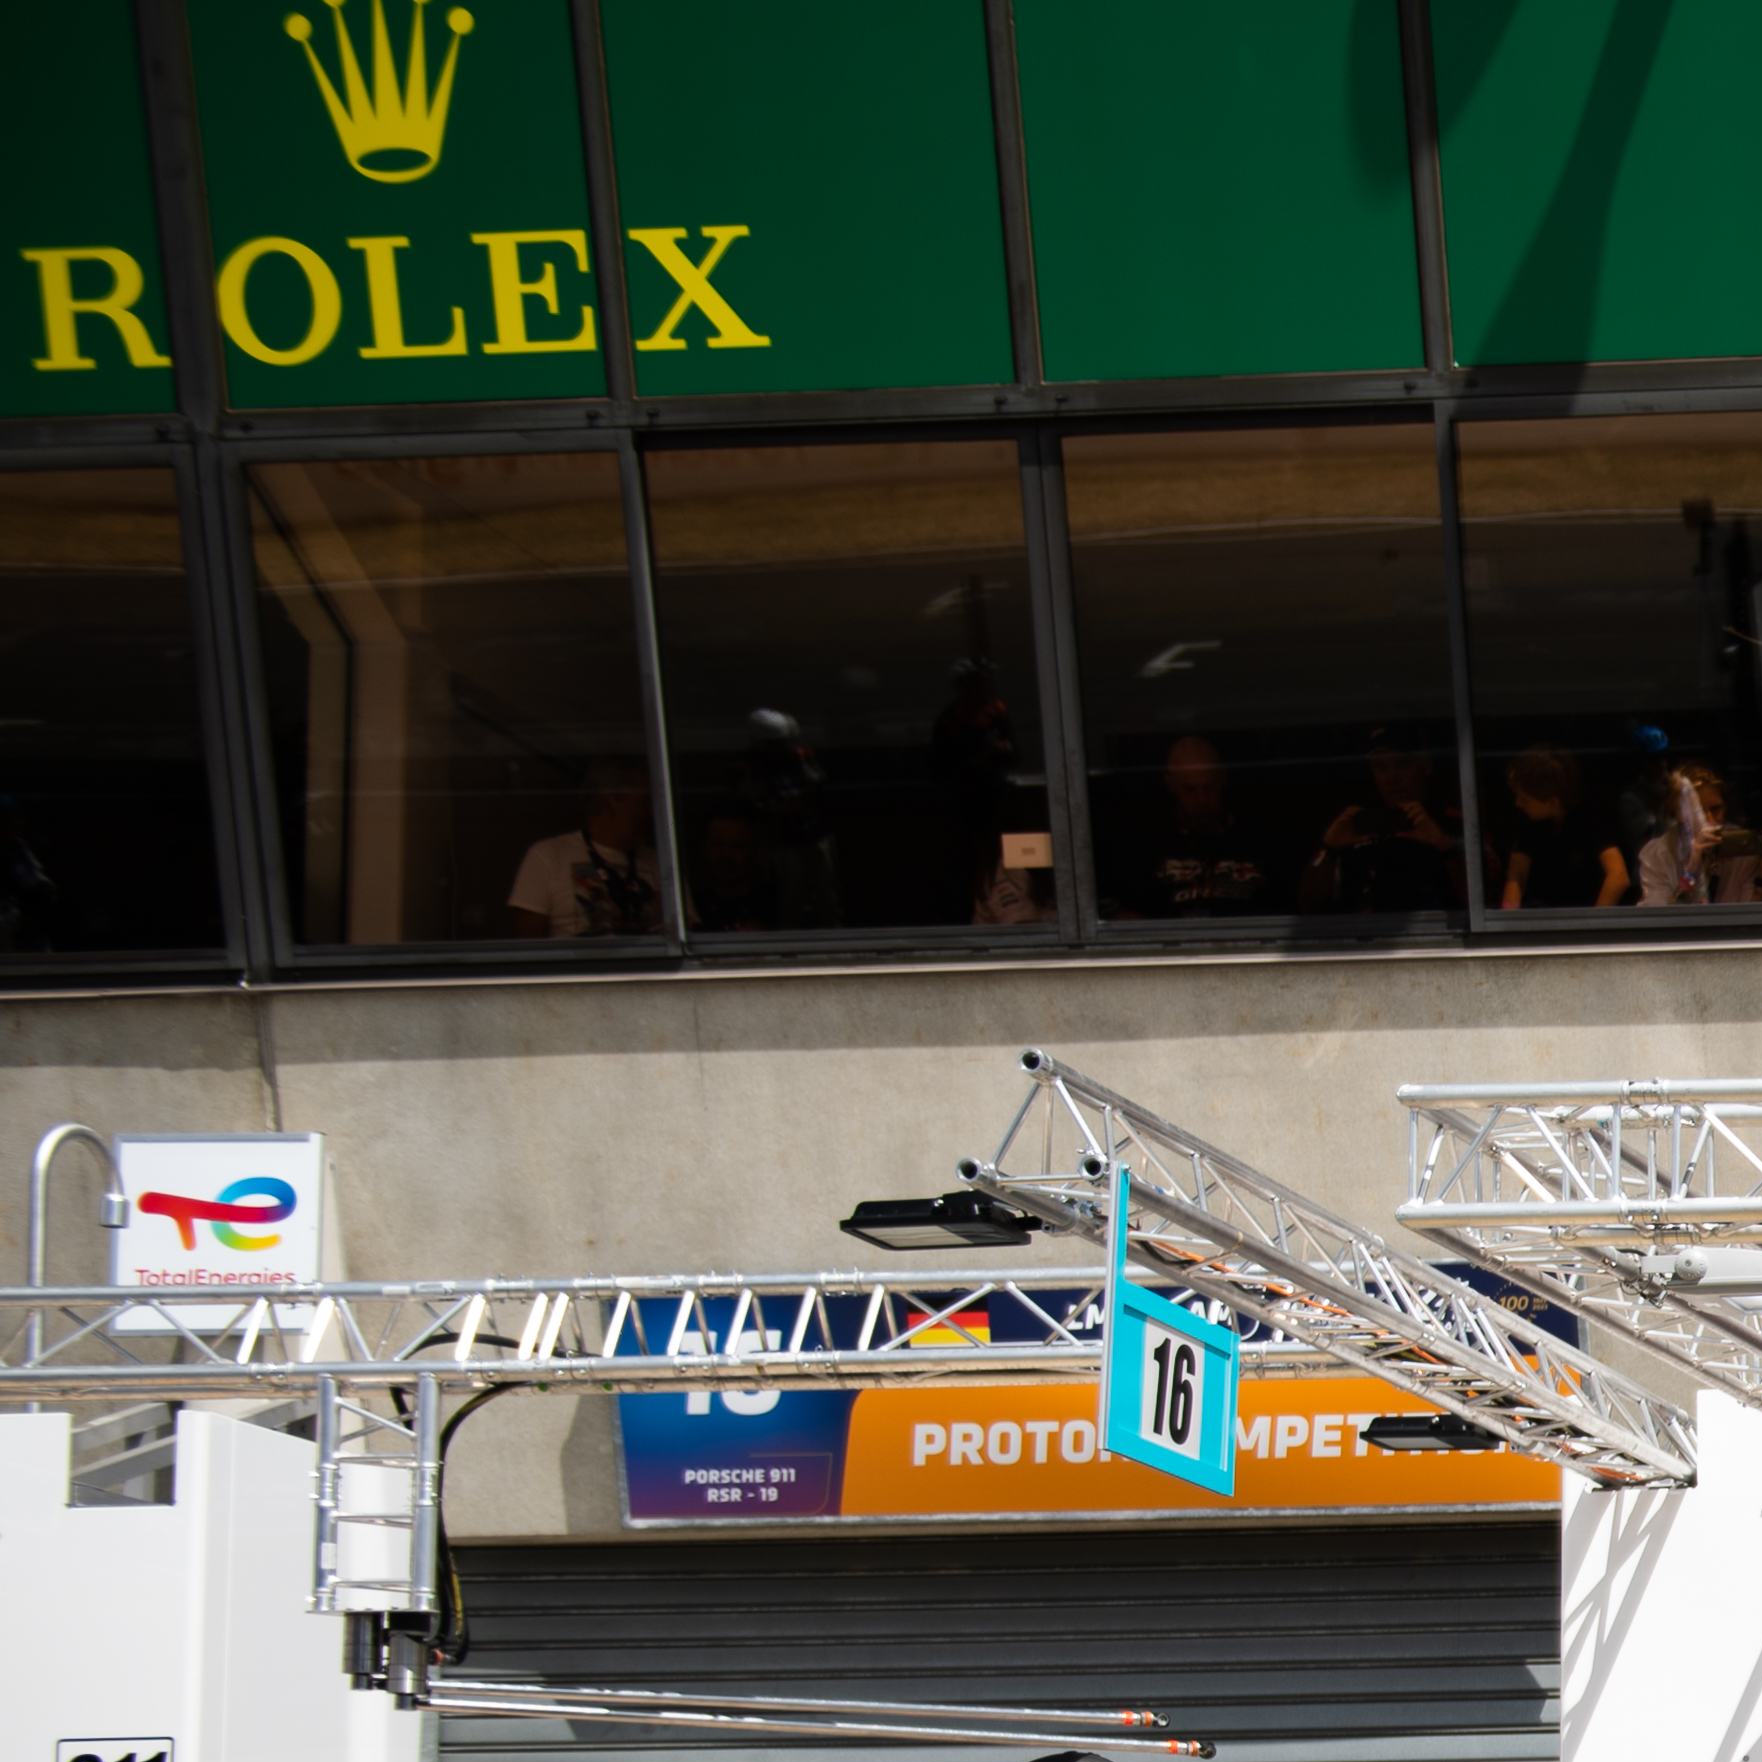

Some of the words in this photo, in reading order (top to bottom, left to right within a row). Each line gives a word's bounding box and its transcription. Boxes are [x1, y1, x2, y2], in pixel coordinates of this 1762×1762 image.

[21, 225, 772, 372] ROLEX
[135, 1269, 295, 1286] TotalEnergies
[1153, 1336, 1197, 1445] 16
[685, 1468, 766, 1485] PORSCHE
[770, 1468, 796, 1484] 911
[707, 1487, 742, 1503] RSR
[760, 1487, 779, 1502] 19
